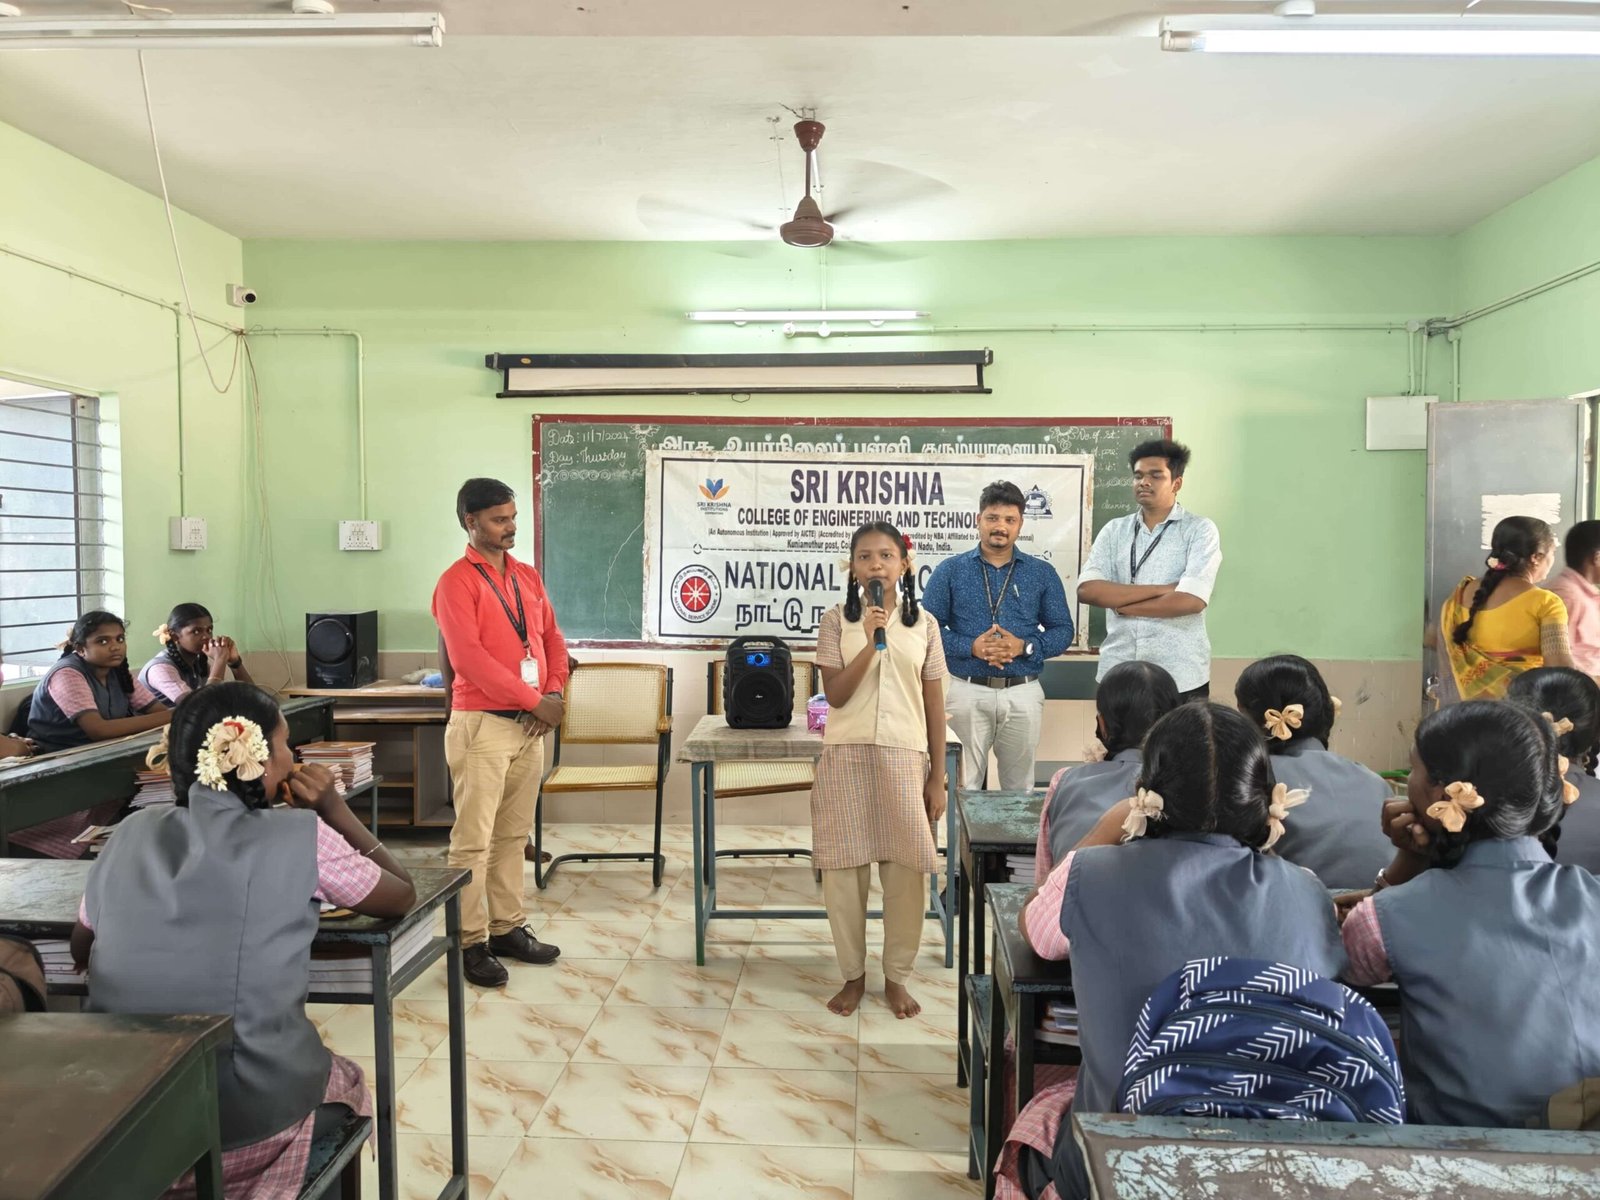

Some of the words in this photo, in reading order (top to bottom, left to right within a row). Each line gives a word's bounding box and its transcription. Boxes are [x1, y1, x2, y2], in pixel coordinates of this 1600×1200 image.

[790, 469, 828, 504] SRI
[837, 470, 945, 506] KRISHNA
[737, 507, 791, 525] COLLEGE
[793, 509, 809, 526] OF
[812, 510, 892, 528] ENGINEERING
[895, 511, 920, 527] AND
[923, 511, 980, 529] TECHNOL
[918, 542, 935, 552] Nadu,
[936, 542, 953, 551] India.
[933, 532, 944, 540] NBA
[725, 561, 841, 591] NATIONAL
[734, 597, 803, 632] நாட்டு
